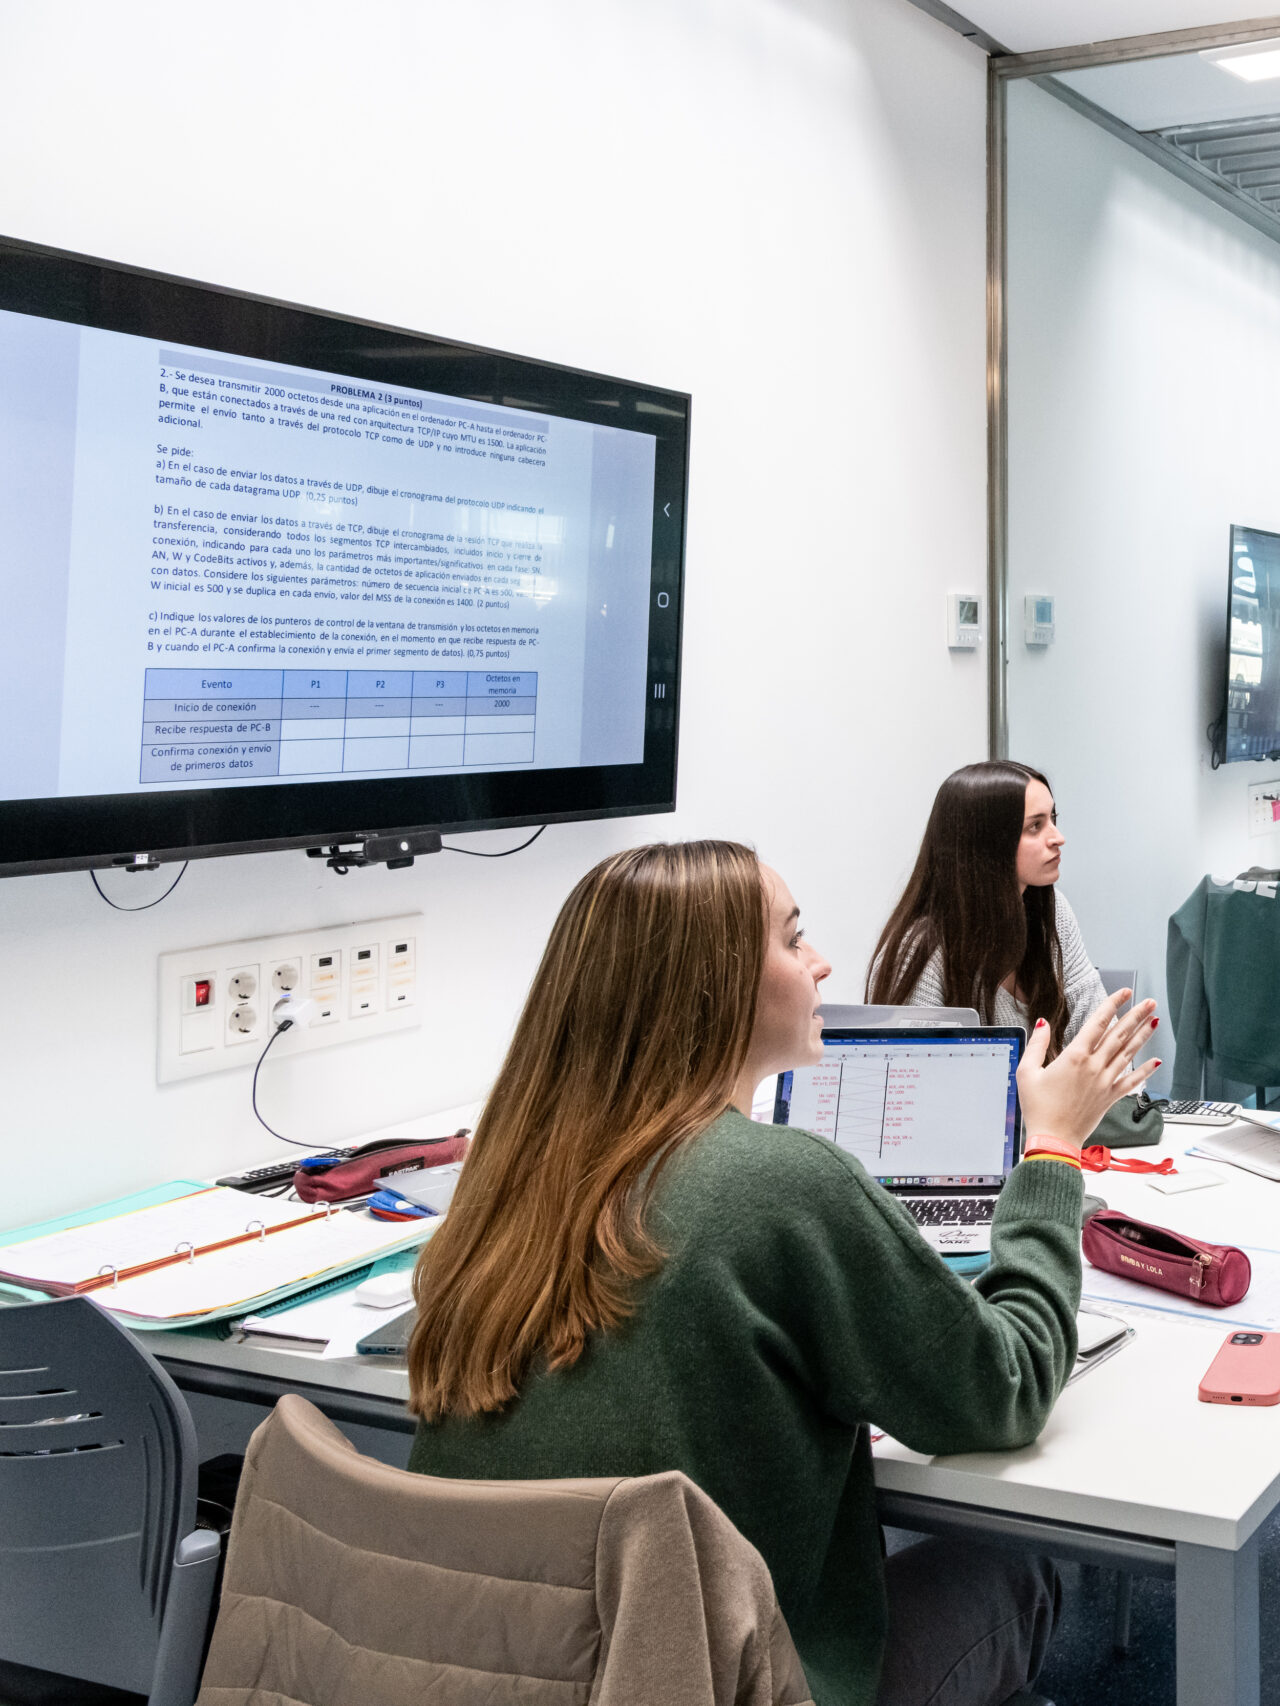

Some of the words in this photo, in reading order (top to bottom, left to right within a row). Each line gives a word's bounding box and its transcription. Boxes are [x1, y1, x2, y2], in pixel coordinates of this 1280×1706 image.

[330, 384, 375, 400] PROBLEMA
[378, 393, 383, 401] 2
[384, 393, 392, 404] (3
[394, 397, 422, 410] puntos)
[175, 371, 185, 380] Se
[188, 373, 215, 385] desea
[218, 379, 260, 393] transmitir
[264, 386, 285, 397] 2000
[287, 392, 318, 402] octetos
[320, 395, 343, 407] desde
[412, 411, 418, 419] el
[420, 413, 456, 425] ordenador
[476, 422, 493, 432] hasta
[495, 425, 501, 433] el
[502, 427, 534, 438] ordenador
[171, 388, 188, 397] que
[220, 396, 270, 409] conectados
[308, 408, 317, 417] de
[320, 412, 334, 420] una
[337, 414, 350, 422] red
[369, 420, 414, 432] arquitectura
[442, 432, 458, 441] cuyo
[460, 433, 476, 442] MTU
[158, 401, 195, 412] permite
[200, 405, 209, 414] el
[242, 412, 265, 423] tanto
[307, 421, 319, 431] del
[322, 426, 361, 437] protocolo
[365, 431, 379, 440] TCP
[381, 435, 402, 444] como
[405, 437, 414, 445] de
[418, 439, 433, 448] UDP
[455, 445, 486, 456] introduce
[489, 451, 514, 461] ninguna
[518, 455, 546, 465] cabecera
[157, 443, 167, 452] Se
[155, 460, 165, 471] a)
[168, 461, 179, 470] En
[182, 463, 191, 472] el
[193, 466, 214, 474] caso
[216, 466, 227, 476] de
[230, 470, 256, 479] enviar
[260, 472, 272, 481] los
[274, 473, 297, 484] datos
[333, 481, 342, 490] de
[366, 485, 388, 497] dibuje
[391, 488, 398, 496] el
[400, 491, 442, 501] cronograma
[195, 479, 206, 488] de
[209, 482, 230, 491] cada
[233, 483, 279, 496] datagrama
[282, 490, 300, 499] UDP
[148, 611, 157, 622] c)
[160, 612, 194, 623] Indique
[198, 613, 211, 622] los
[213, 614, 245, 623] valores
[247, 615, 258, 623] de
[260, 615, 272, 624] los
[274, 618, 311, 626] punteros
[314, 617, 324, 625] de
[326, 618, 354, 626] control
[356, 619, 365, 627] de
[367, 619, 374, 627] la
[407, 620, 415, 628] de
[163, 626, 171, 635] el
[200, 627, 235, 637] durante
[239, 629, 247, 637] el
[249, 629, 315, 639] establecimiento
[319, 631, 329, 639] de
[332, 631, 338, 639] la
[391, 633, 398, 641] el
[202, 680, 232, 689] Evento
[311, 681, 320, 689] P1
[486, 675, 511, 683] Octetos
[175, 703, 199, 712] Inicio
[202, 704, 213, 712] de
[216, 703, 256, 712] conexión
[155, 725, 186, 735] Recibe
[190, 725, 233, 734] respuesta
[237, 724, 247, 732] de
[250, 723, 271, 732] PC-B
[151, 747, 194, 757] Confirma
[198, 746, 239, 755] conexión
[242, 747, 246, 755] y
[249, 745, 271, 753] envío
[171, 762, 182, 771] de
[185, 761, 225, 772] primeros
[229, 760, 253, 768] datos
[1147, 1265, 1163, 1275] LOLA
